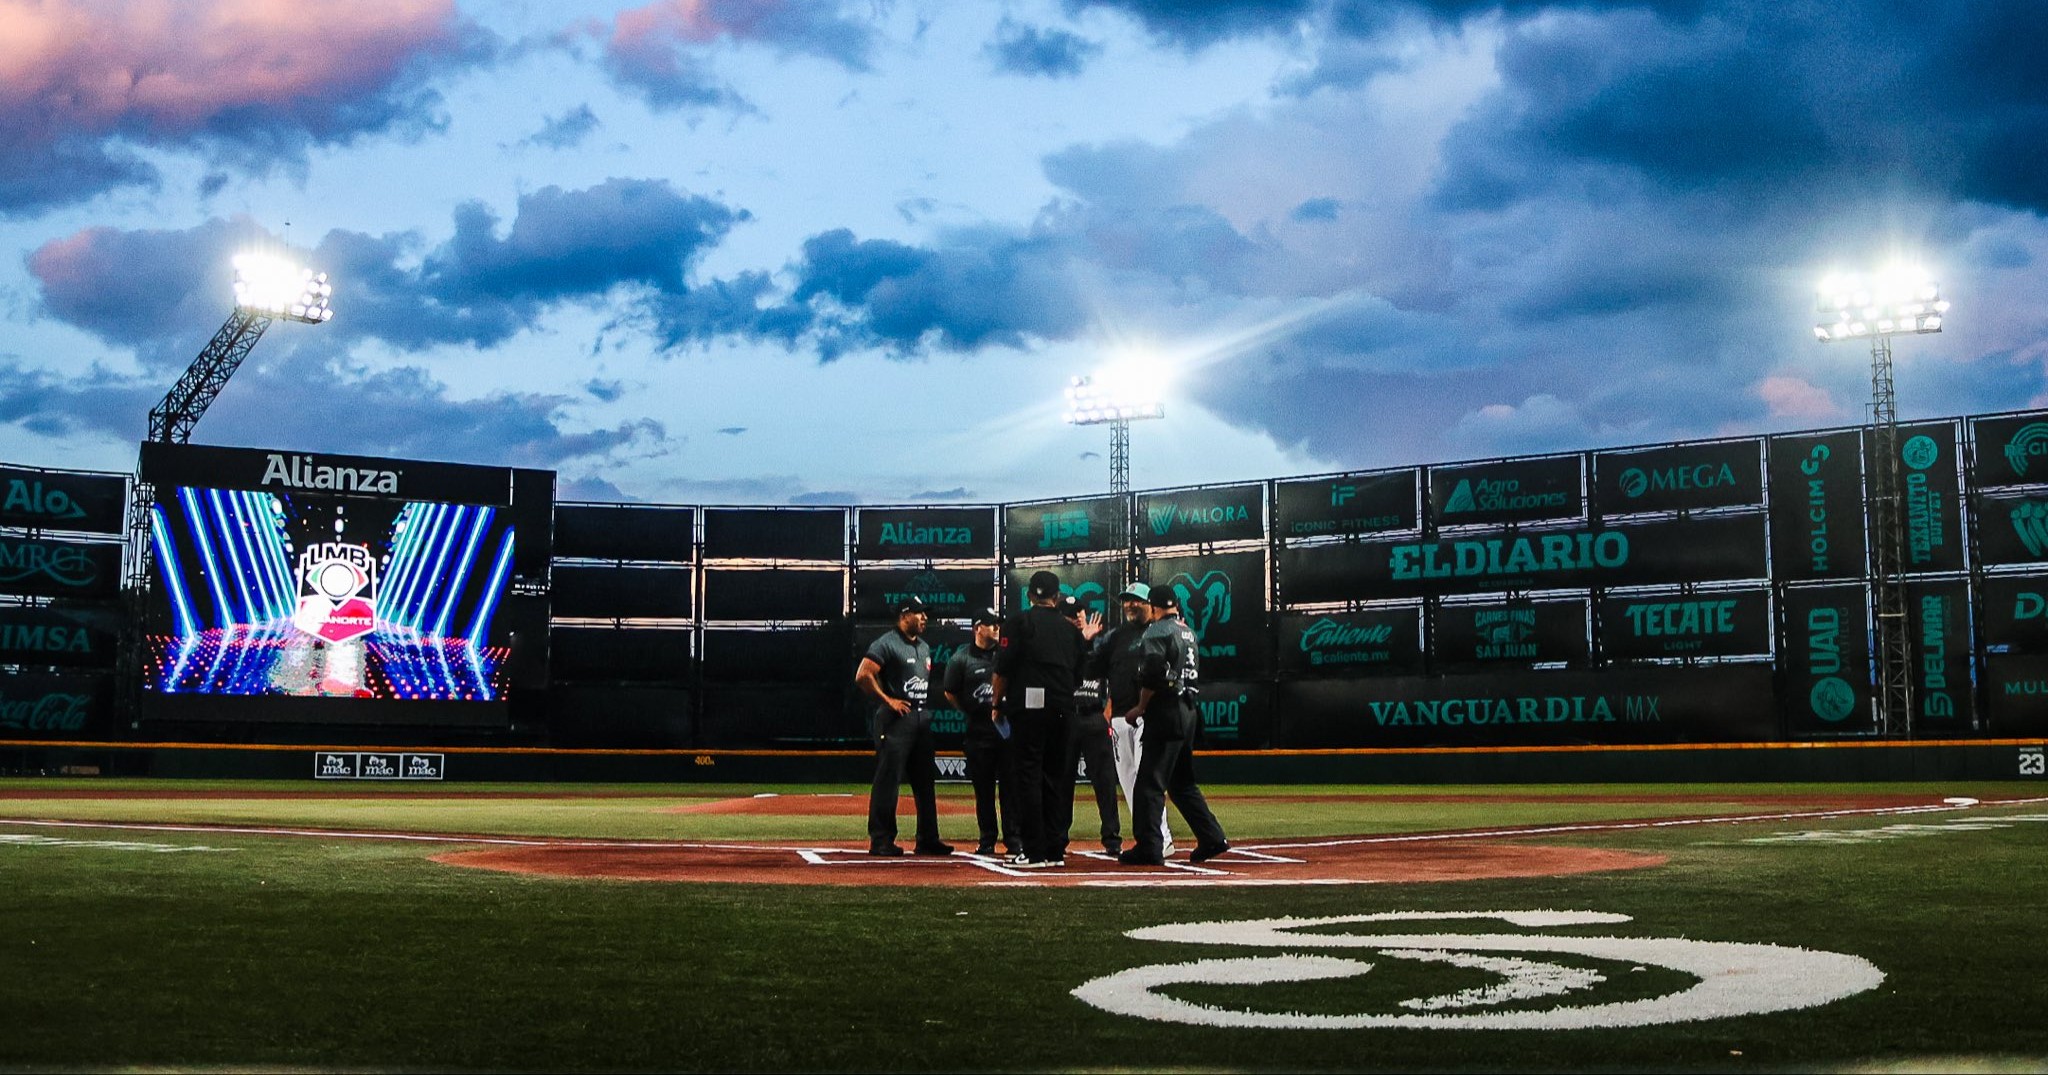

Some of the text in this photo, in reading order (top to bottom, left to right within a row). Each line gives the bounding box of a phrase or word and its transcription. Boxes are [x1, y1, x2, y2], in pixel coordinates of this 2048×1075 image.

[261, 453, 398, 493] Alianza
[3, 478, 70, 515] Alo
[1476, 478, 1520, 498] Agro
[1478, 492, 1568, 511] Soluciones
[1177, 504, 1248, 526] VALORA
[1342, 515, 1400, 530] FITNESS
[1808, 479, 1829, 571] HOLCIM
[1929, 491, 1944, 546] BUFFET
[879, 521, 972, 545] Alianza
[310, 546, 367, 568] LMB
[1475, 609, 1536, 628] CARNES FINAS
[1624, 600, 1738, 637] TECATE
[1300, 618, 1393, 652] Caliente
[1808, 608, 1841, 675] UAD
[1475, 642, 1537, 660] SAN JUAN
[1368, 696, 1662, 726] VANGUARDIA MX
[2019, 753, 2046, 774] 23
